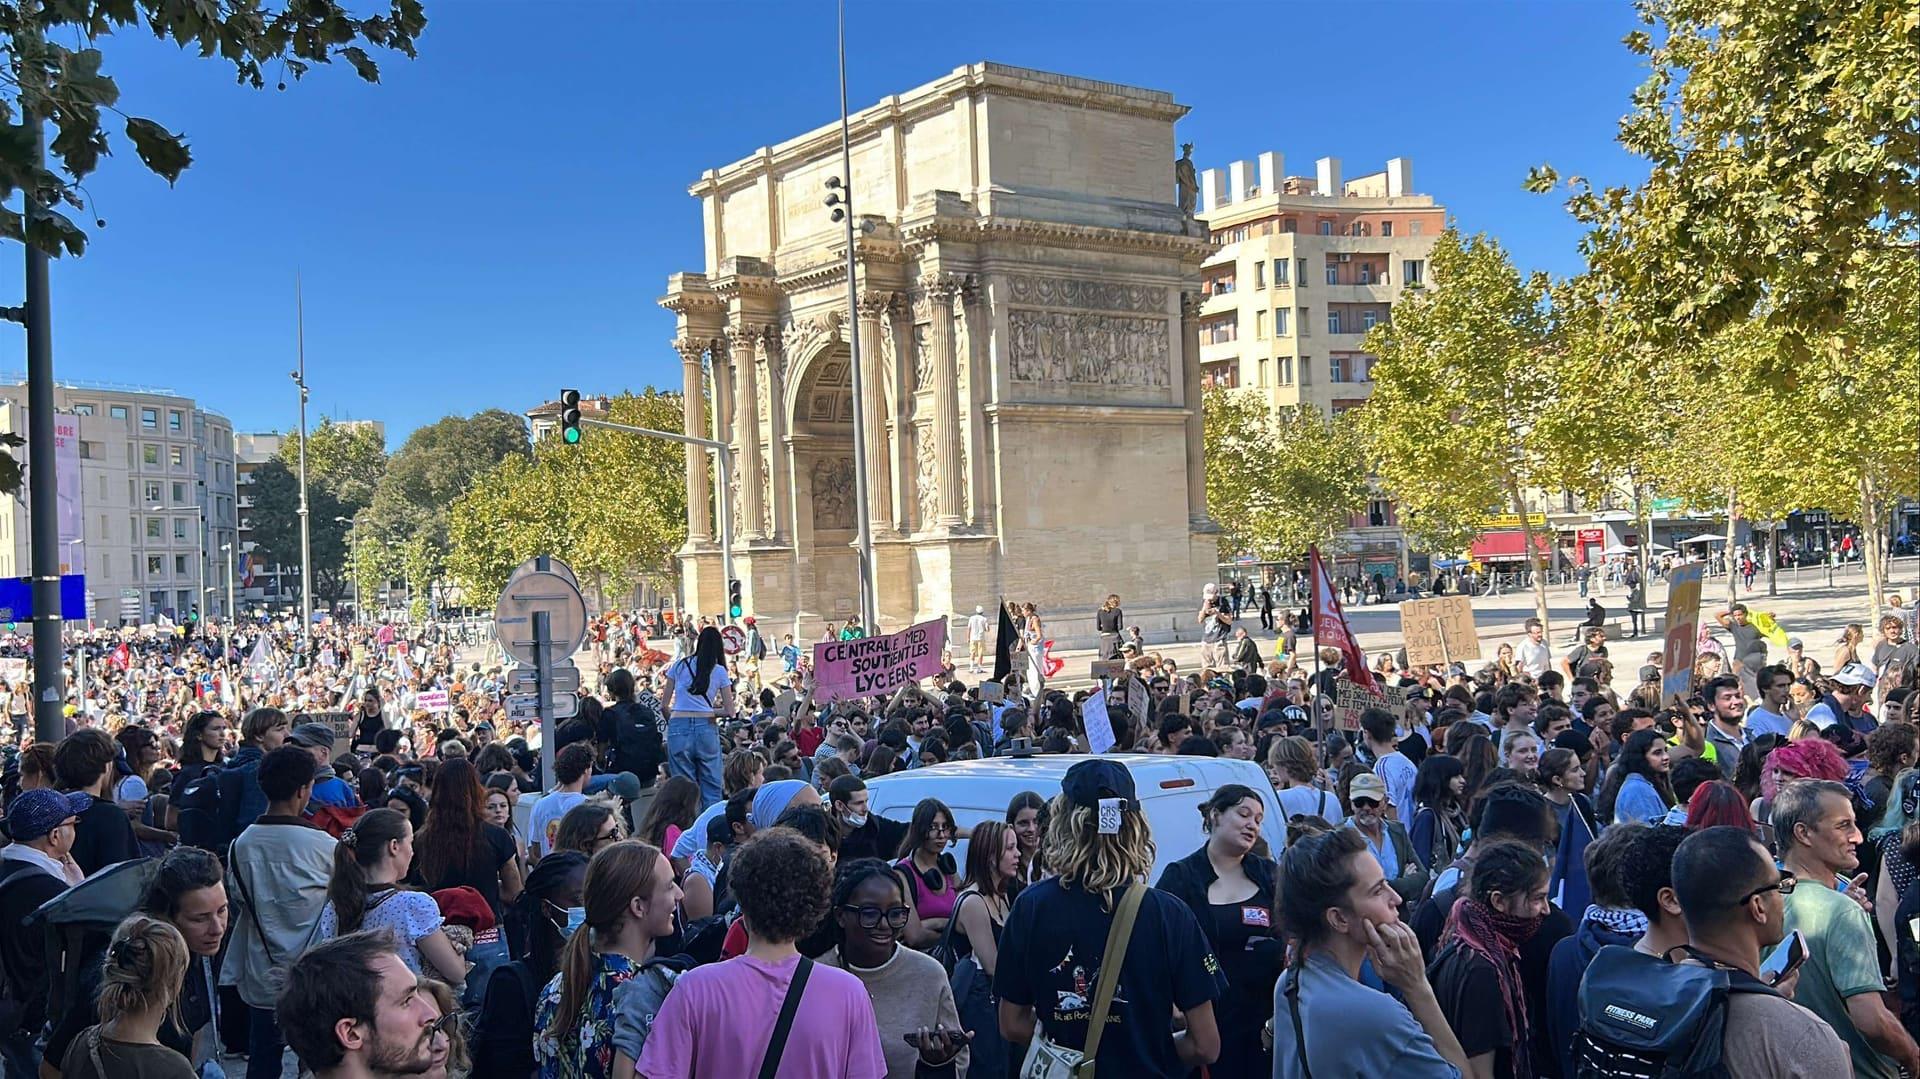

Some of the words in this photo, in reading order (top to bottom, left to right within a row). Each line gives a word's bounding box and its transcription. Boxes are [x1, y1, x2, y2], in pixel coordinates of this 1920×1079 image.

[1404, 600, 1436, 617] LIFE
[1443, 598, 1464, 614] AS
[1404, 620, 1413, 633] A
[824, 637, 899, 663] CENTRALE
[905, 629, 927, 646] MED
[912, 642, 929, 659] LES
[855, 661, 917, 693] LYCÉENS
[1100, 806, 1116, 817] CRS
[1100, 817, 1116, 829] SS
[1605, 1004, 1636, 1019] FITNESS
[1633, 1014, 1657, 1027] PARK
